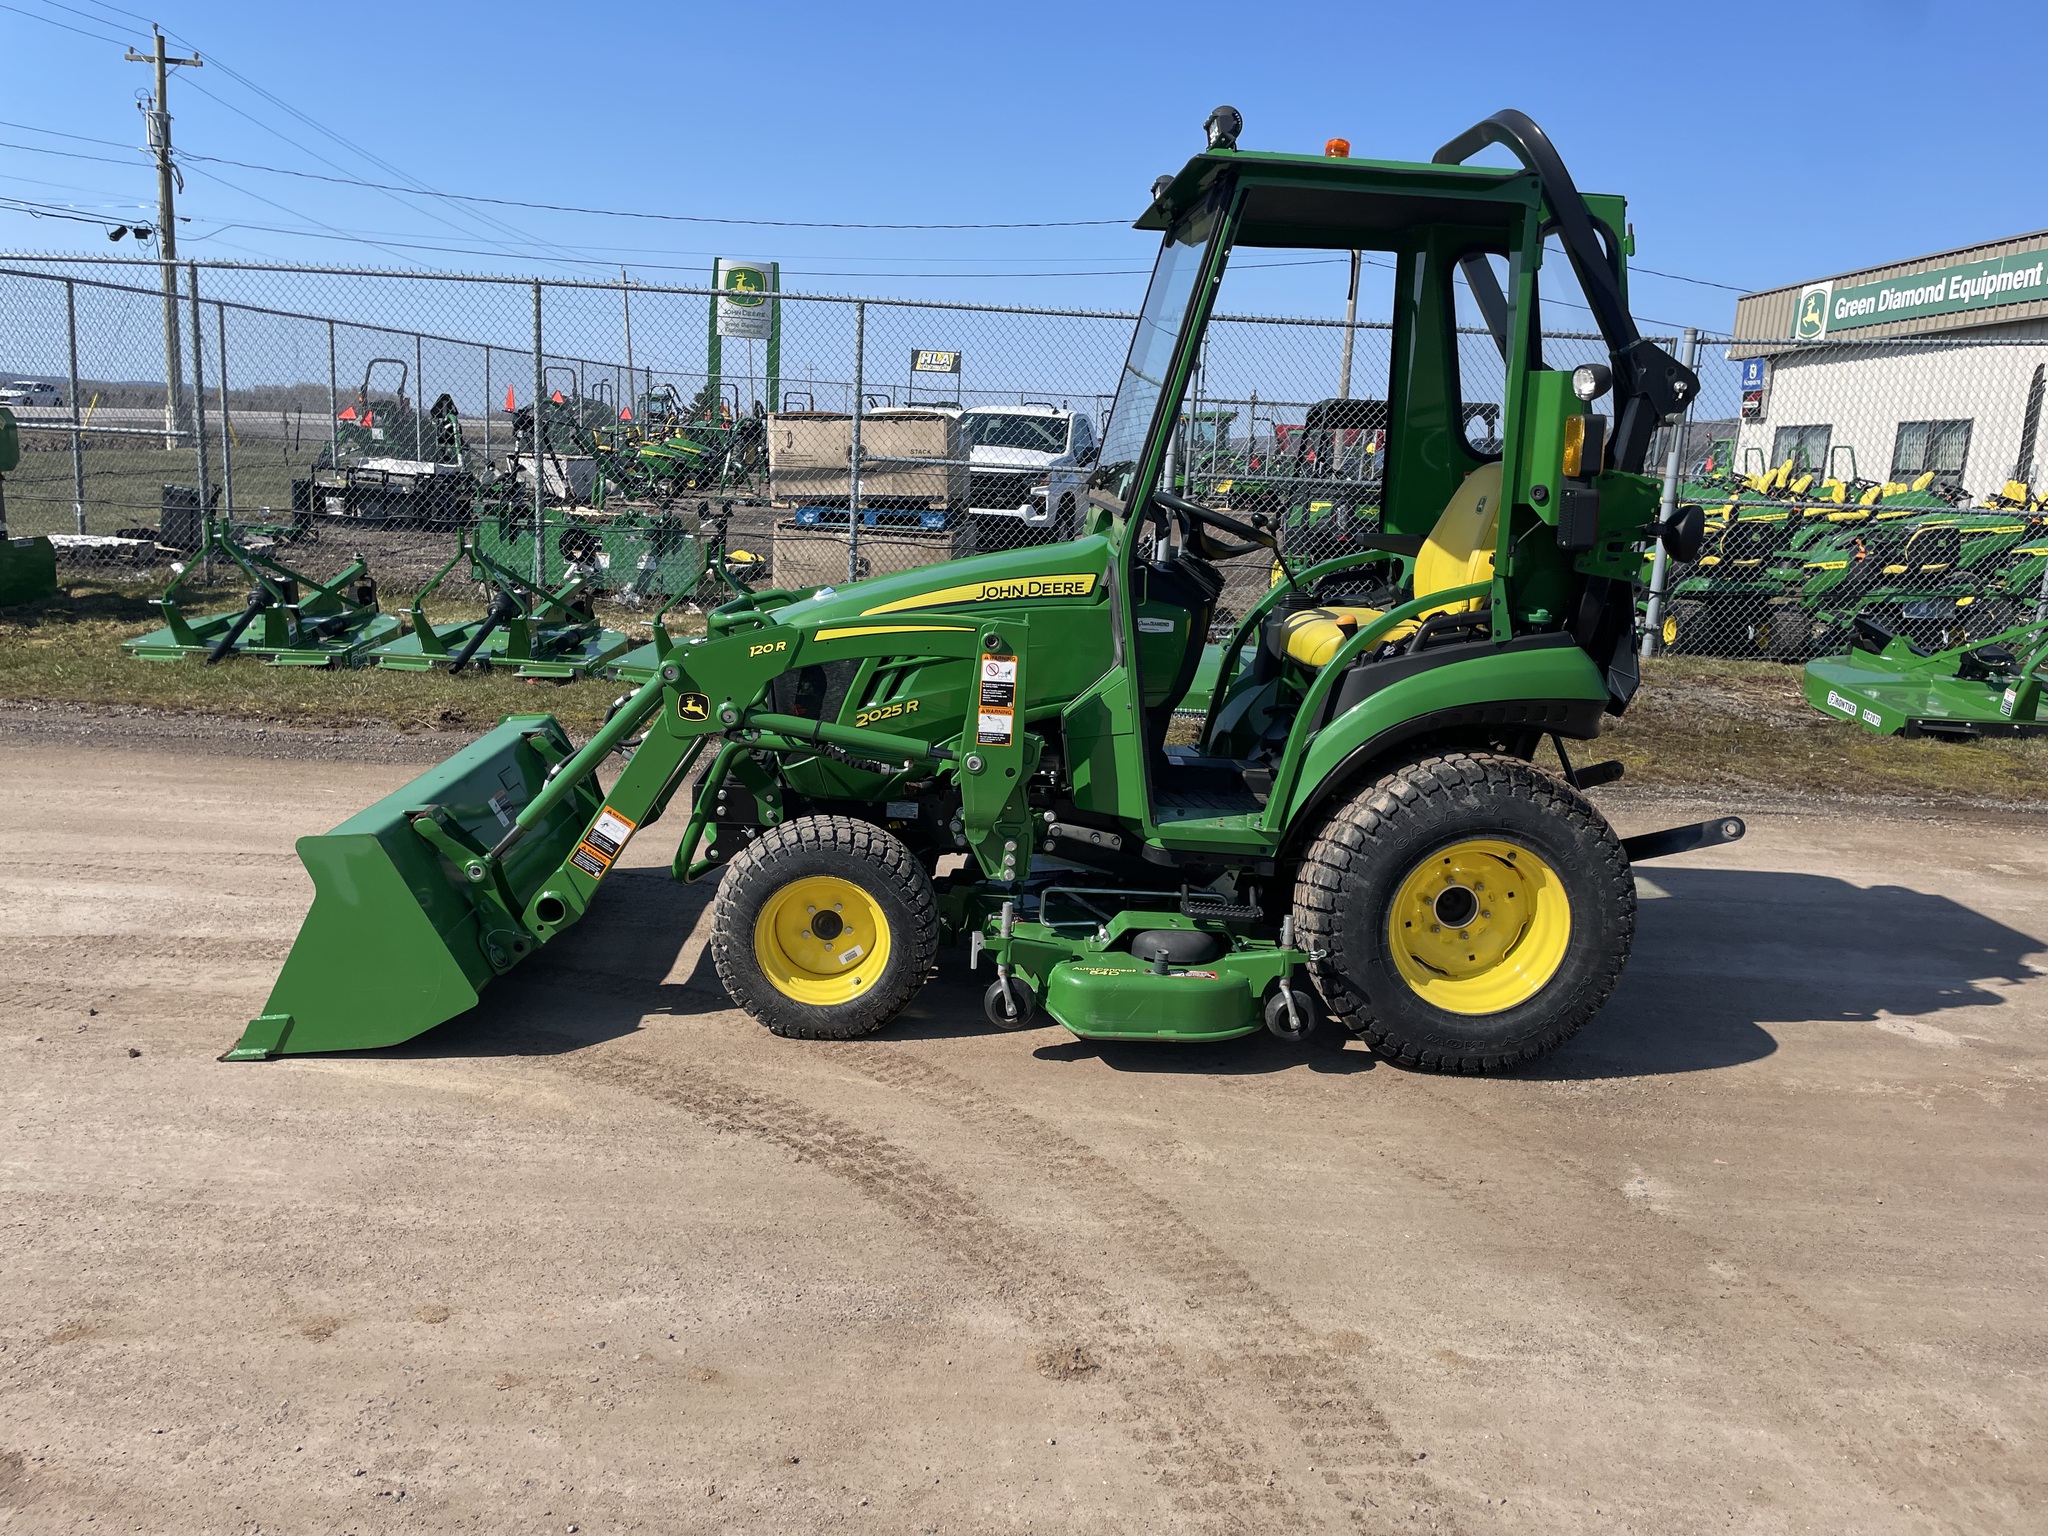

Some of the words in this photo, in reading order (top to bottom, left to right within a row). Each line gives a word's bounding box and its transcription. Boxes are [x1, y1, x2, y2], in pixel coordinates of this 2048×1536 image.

[1834, 296, 1876, 320] Green
[1877, 277, 1946, 312] Diamond
[1948, 261, 2044, 304] Equipment
[723, 308, 742, 317] JOHN
[920, 352, 951, 366] HLA
[976, 585, 1024, 600] JOHN
[1028, 581, 1085, 596] DEERE
[749, 643, 774, 658] 120
[775, 641, 787, 652] R
[855, 703, 903, 728] 2025
[905, 699, 920, 714] R
[985, 708, 1012, 716] WARNING
[612, 811, 632, 827] WARNING
[587, 848, 607, 864] WARNING
[1500, 974, 1593, 1047] MIGHTY
[1423, 1032, 1488, 1050] MOW
